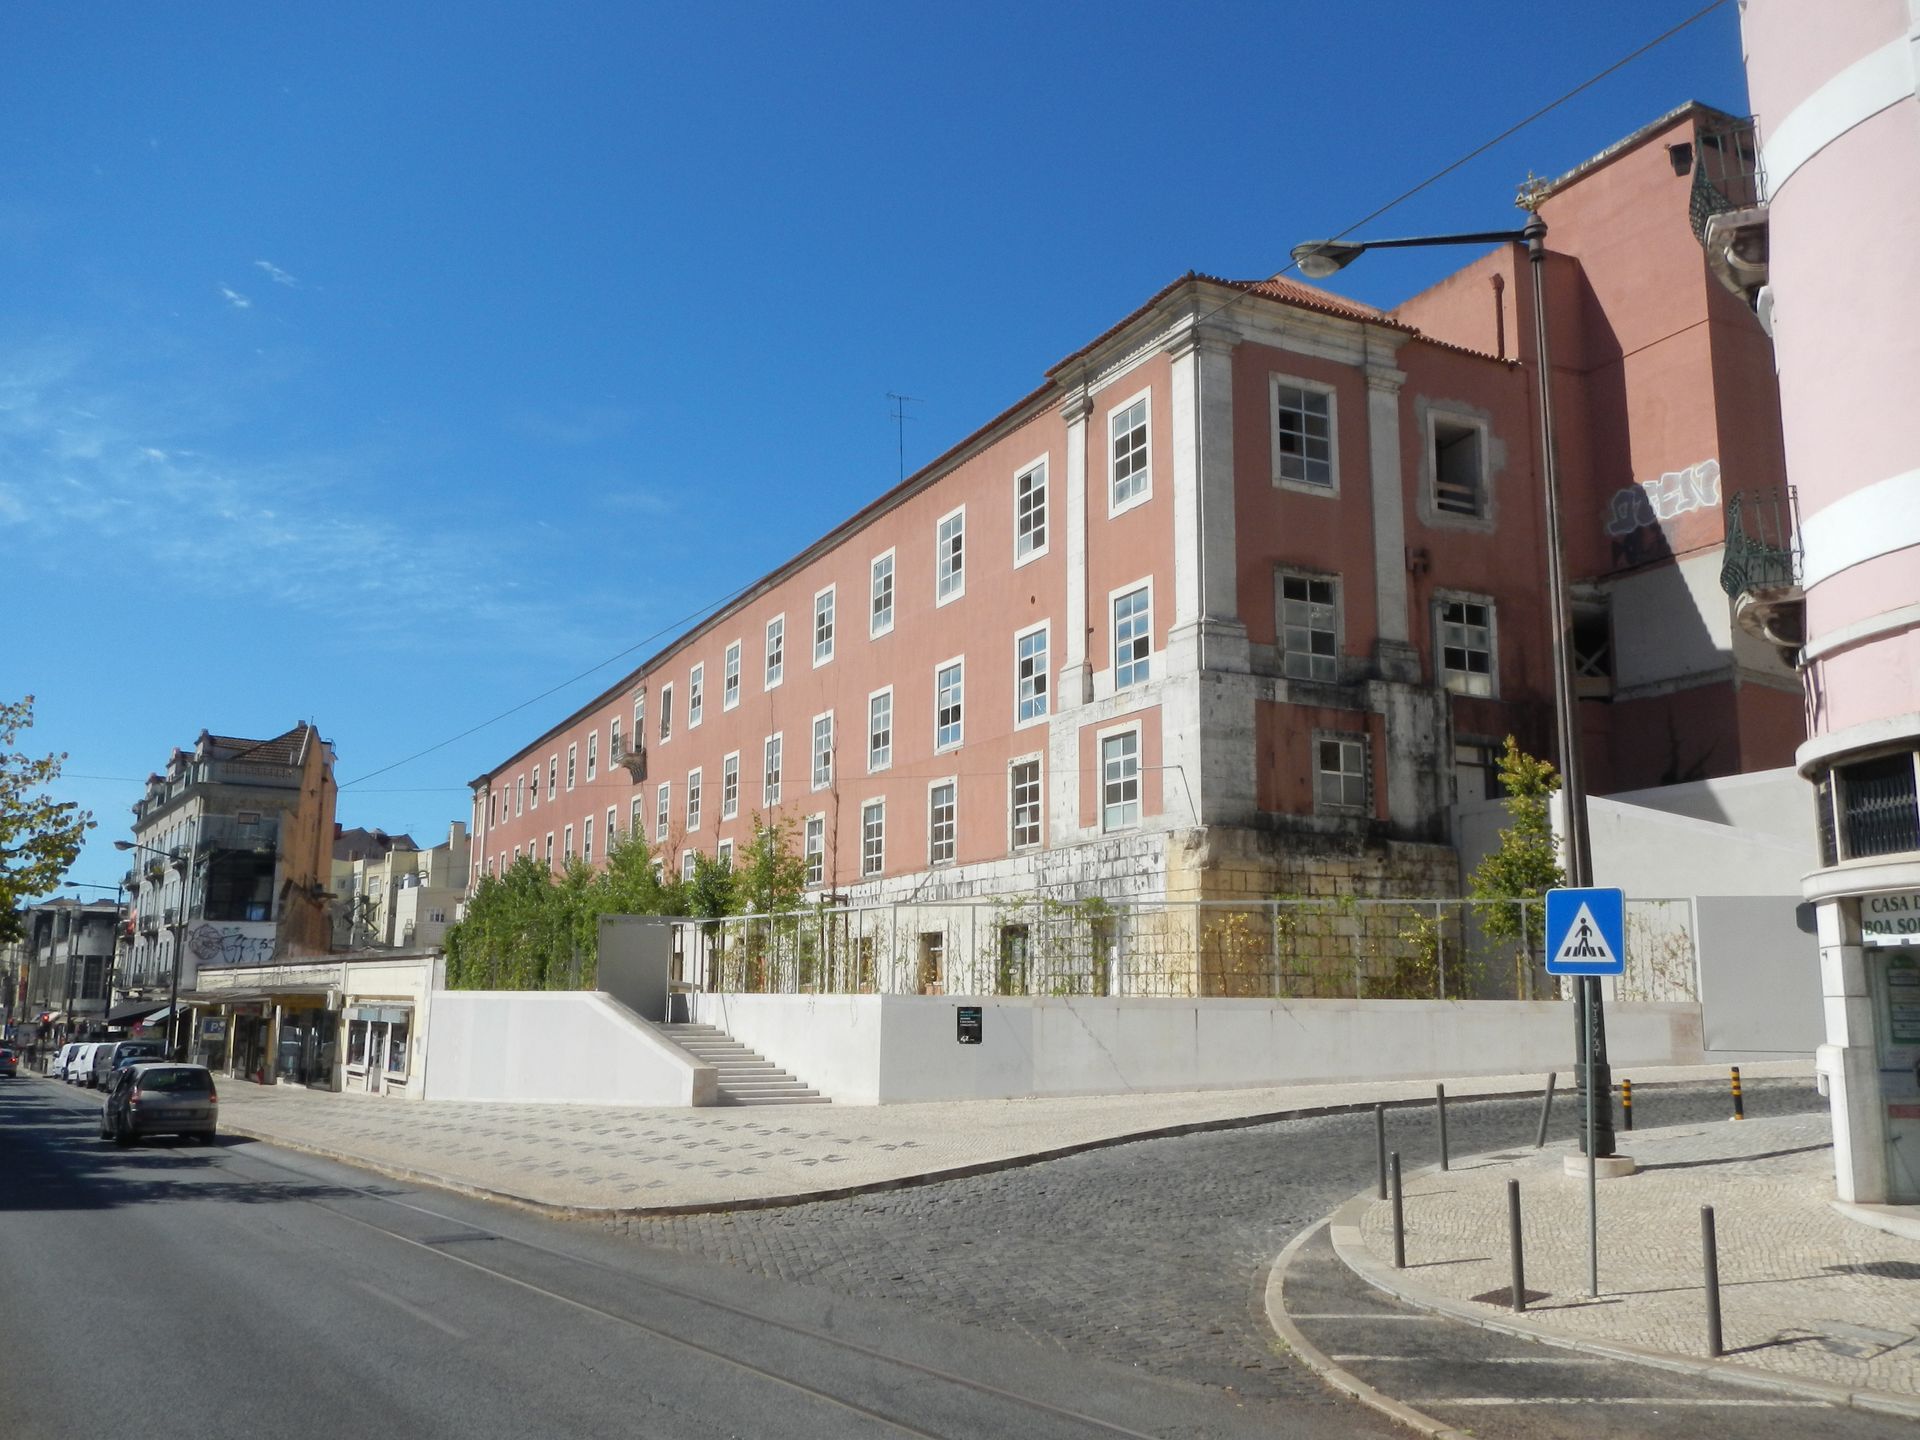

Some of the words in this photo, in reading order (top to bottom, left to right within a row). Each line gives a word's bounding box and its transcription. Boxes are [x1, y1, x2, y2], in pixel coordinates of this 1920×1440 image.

[1871, 896, 1909, 913] CASA
[1863, 919, 1893, 936] BOA
[1896, 917, 1920, 935] SO
